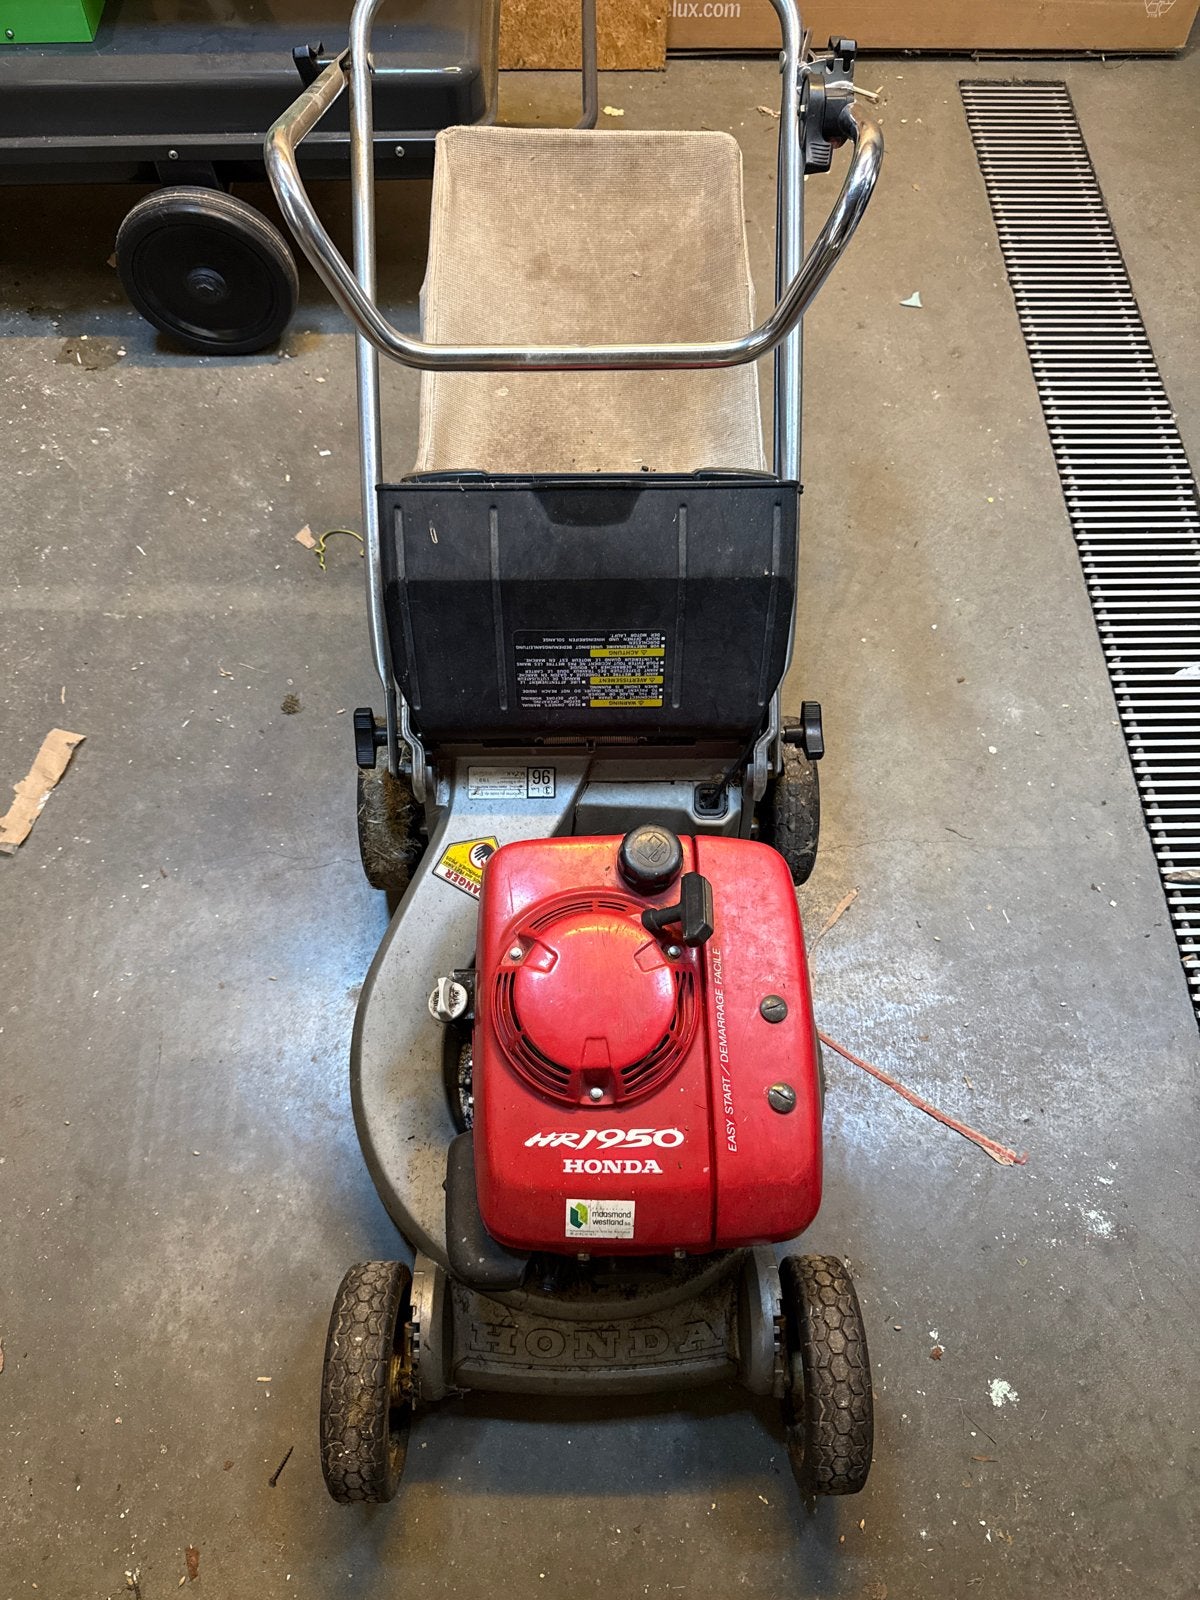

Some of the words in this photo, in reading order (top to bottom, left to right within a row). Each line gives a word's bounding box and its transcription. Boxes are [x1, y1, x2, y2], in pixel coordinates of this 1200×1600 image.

[532, 770, 550, 784] 96
[445, 869, 481, 896] ANGER
[712, 948, 724, 985] FACILE
[715, 989, 729, 1063] DEMARRAGE
[722, 1078, 734, 1115] START
[524, 1128, 684, 1150] HR1950
[725, 1120, 737, 1152] EASY
[562, 1159, 664, 1174] HONDA
[470, 1320, 724, 1360] HONDA
